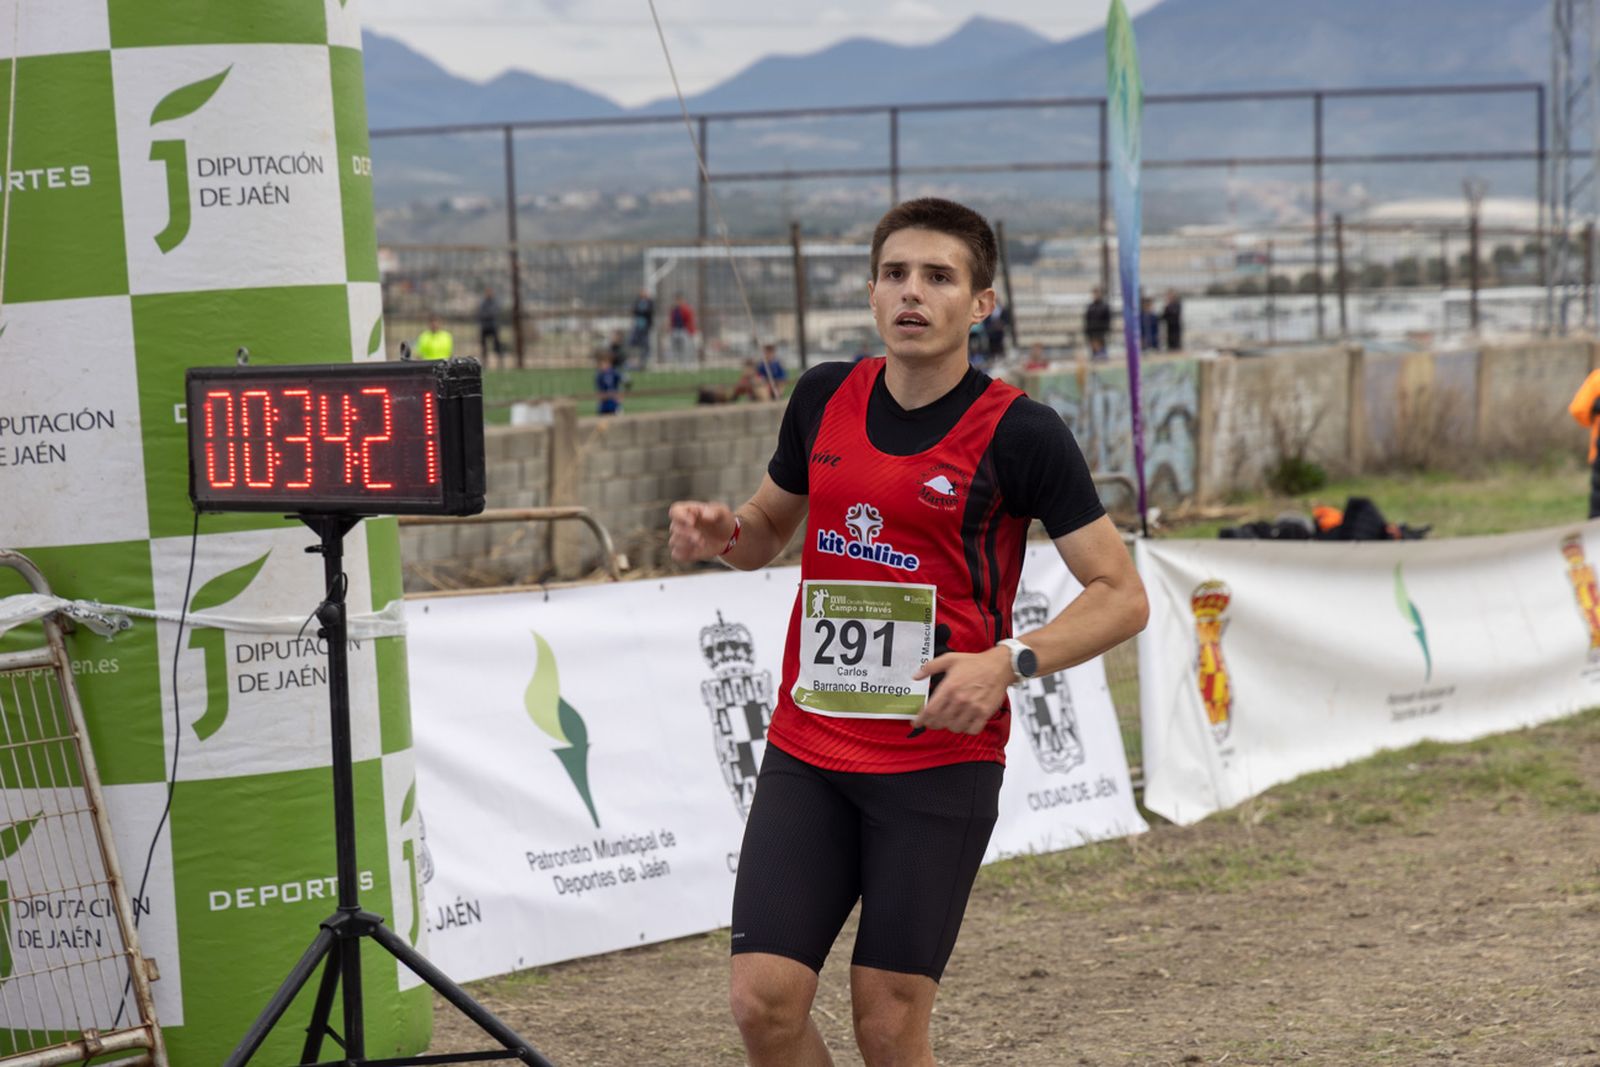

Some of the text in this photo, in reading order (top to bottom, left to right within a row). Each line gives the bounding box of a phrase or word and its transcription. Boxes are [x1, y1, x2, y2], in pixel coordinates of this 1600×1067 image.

[197, 151, 324, 177] DIPUTACIÓN
[0, 165, 91, 192] RTES
[200, 182, 290, 207] DE JAÉN
[11, 441, 67, 466] JAÉN
[818, 530, 918, 570] kit online
[829, 603, 858, 613] Campo
[865, 603, 892, 614] través
[813, 619, 895, 667] 291
[921, 607, 931, 656] Masculino
[236, 637, 361, 664] DIPUTACN
[238, 664, 327, 693] DE JAÉN
[837, 666, 868, 677] Carlos
[813, 680, 912, 697] Barranco Borrego
[1072, 781, 1092, 802] DE
[525, 828, 677, 872] Patronato Municipal de
[552, 856, 671, 897] Deportes de Jaén
[208, 870, 374, 911] DEPORTS
[16, 896, 150, 919] DIPUTACIN
[436, 895, 482, 931] JAÉN
[18, 925, 102, 949] DE JAÉN
